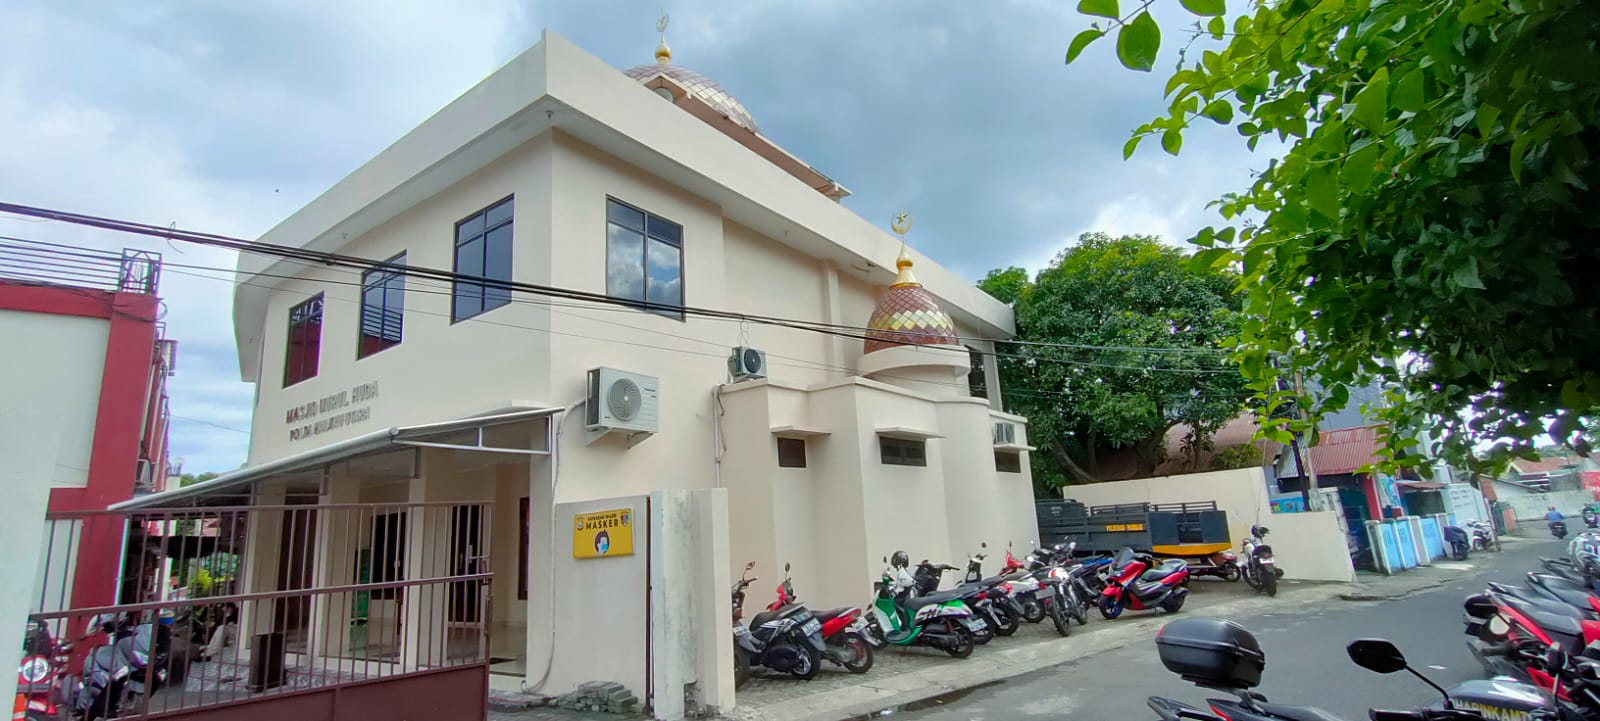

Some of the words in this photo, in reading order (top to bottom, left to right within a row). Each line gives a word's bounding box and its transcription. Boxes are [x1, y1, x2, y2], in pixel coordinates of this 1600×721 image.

[286, 401, 318, 424] MASJID
[351, 380, 379, 404] HUDA
[586, 519, 619, 530] MASKER
